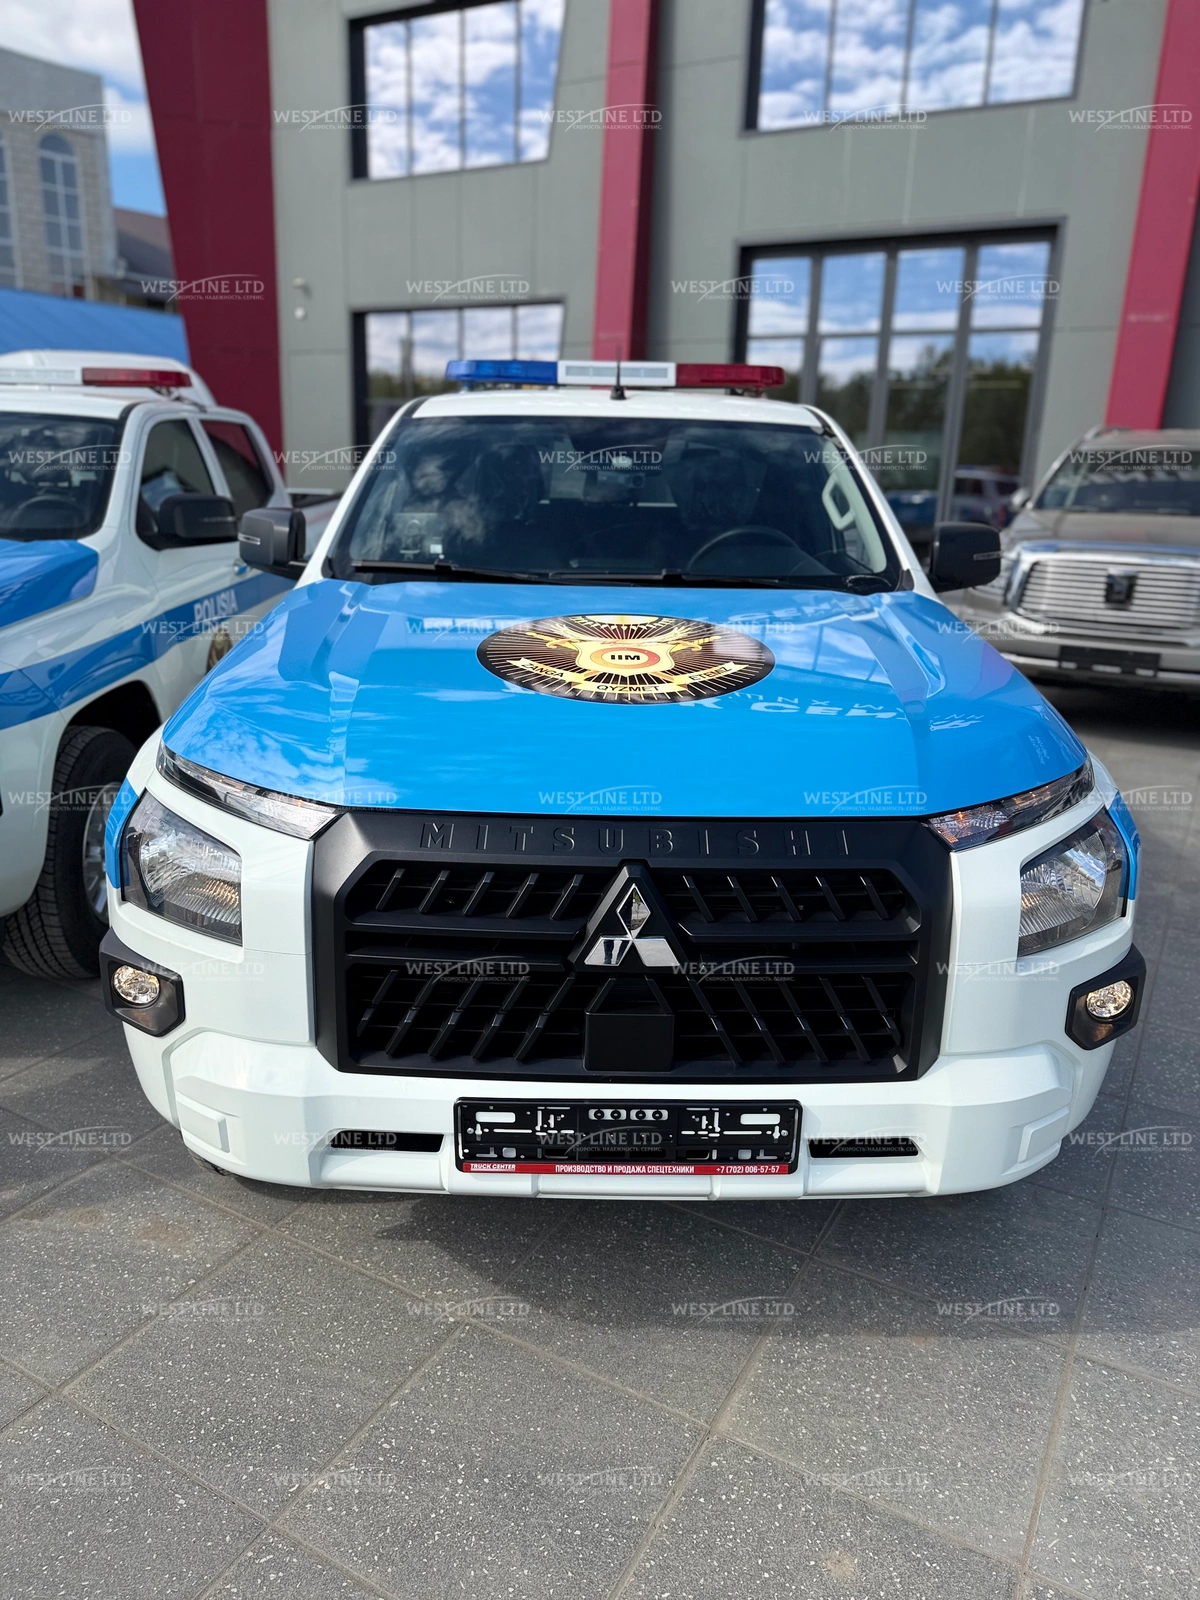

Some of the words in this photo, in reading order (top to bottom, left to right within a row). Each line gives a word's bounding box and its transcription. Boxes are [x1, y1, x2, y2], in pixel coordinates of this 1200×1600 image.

[193, 588, 238, 629] POLISIA
[597, 684, 659, 692] QYZMET
[419, 822, 849, 856] MITSUBISHI
[555, 1164, 606, 1173] ПРОИЗВОДСТВО
[607, 1165, 612, 1173] И
[613, 1165, 647, 1174] ПРОДАЖА
[647, 1165, 695, 1174] СПЕЦТЕХНИКИ
[725, 1165, 744, 1174] (702)
